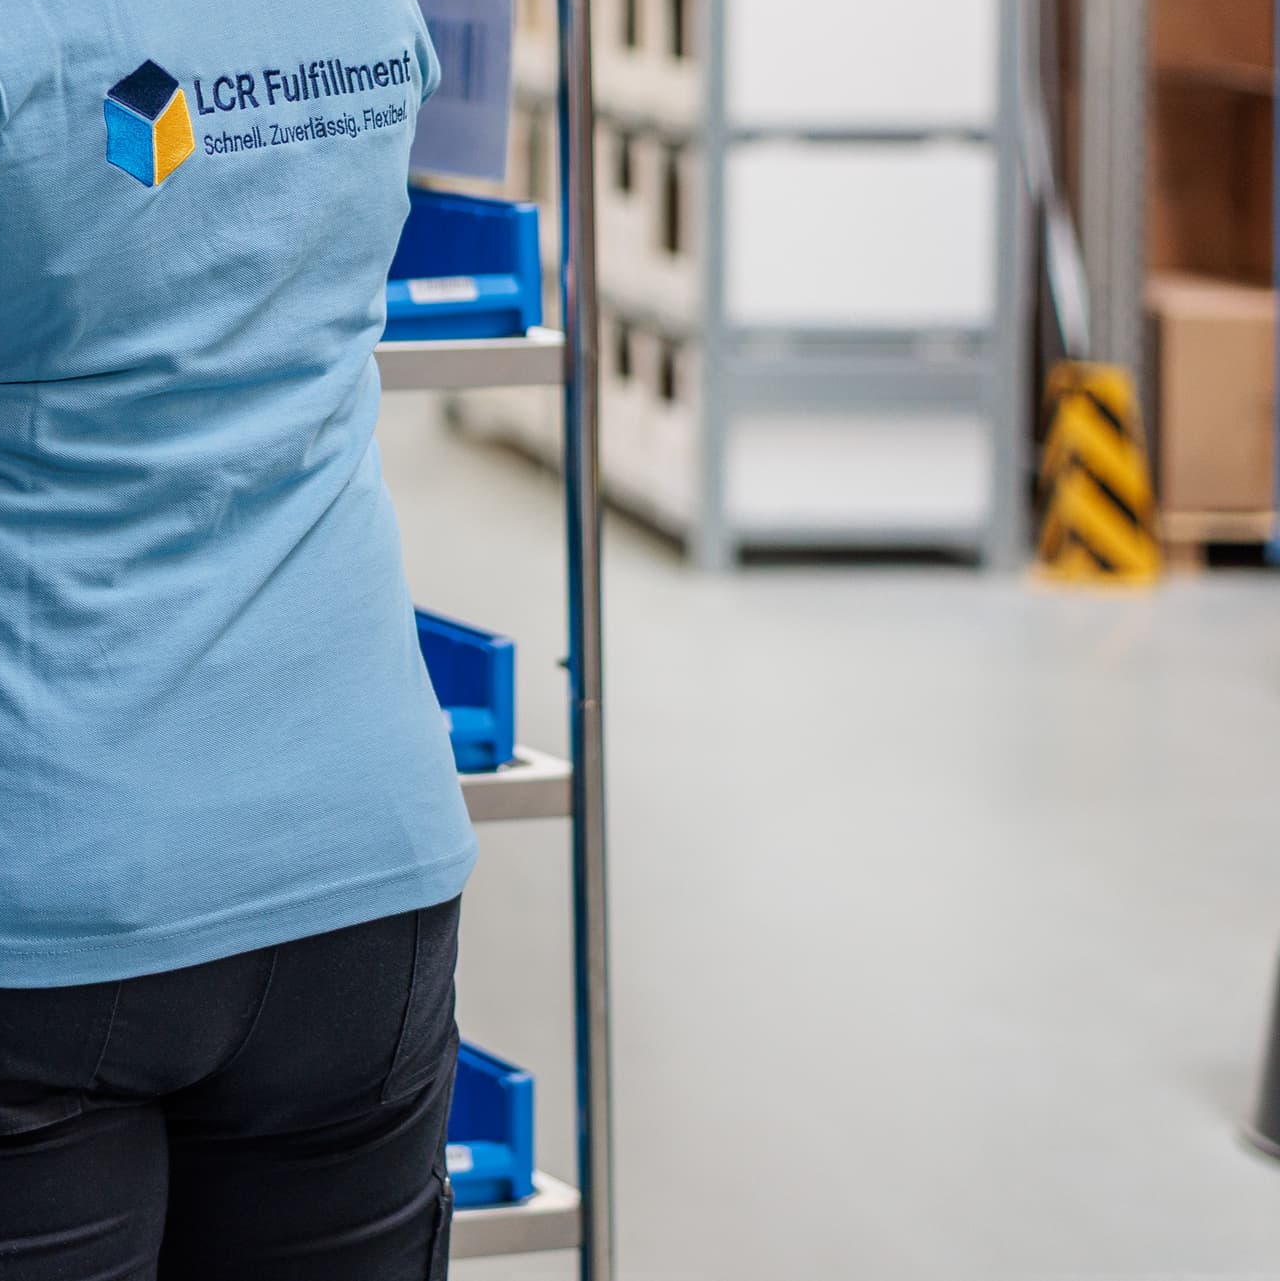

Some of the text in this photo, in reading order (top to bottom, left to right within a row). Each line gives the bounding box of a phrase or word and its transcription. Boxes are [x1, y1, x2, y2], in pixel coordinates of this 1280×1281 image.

[194, 50, 411, 115] LCR Fulfillment
[203, 100, 408, 156] Schnell. Zuverlässig. Flexibel.
